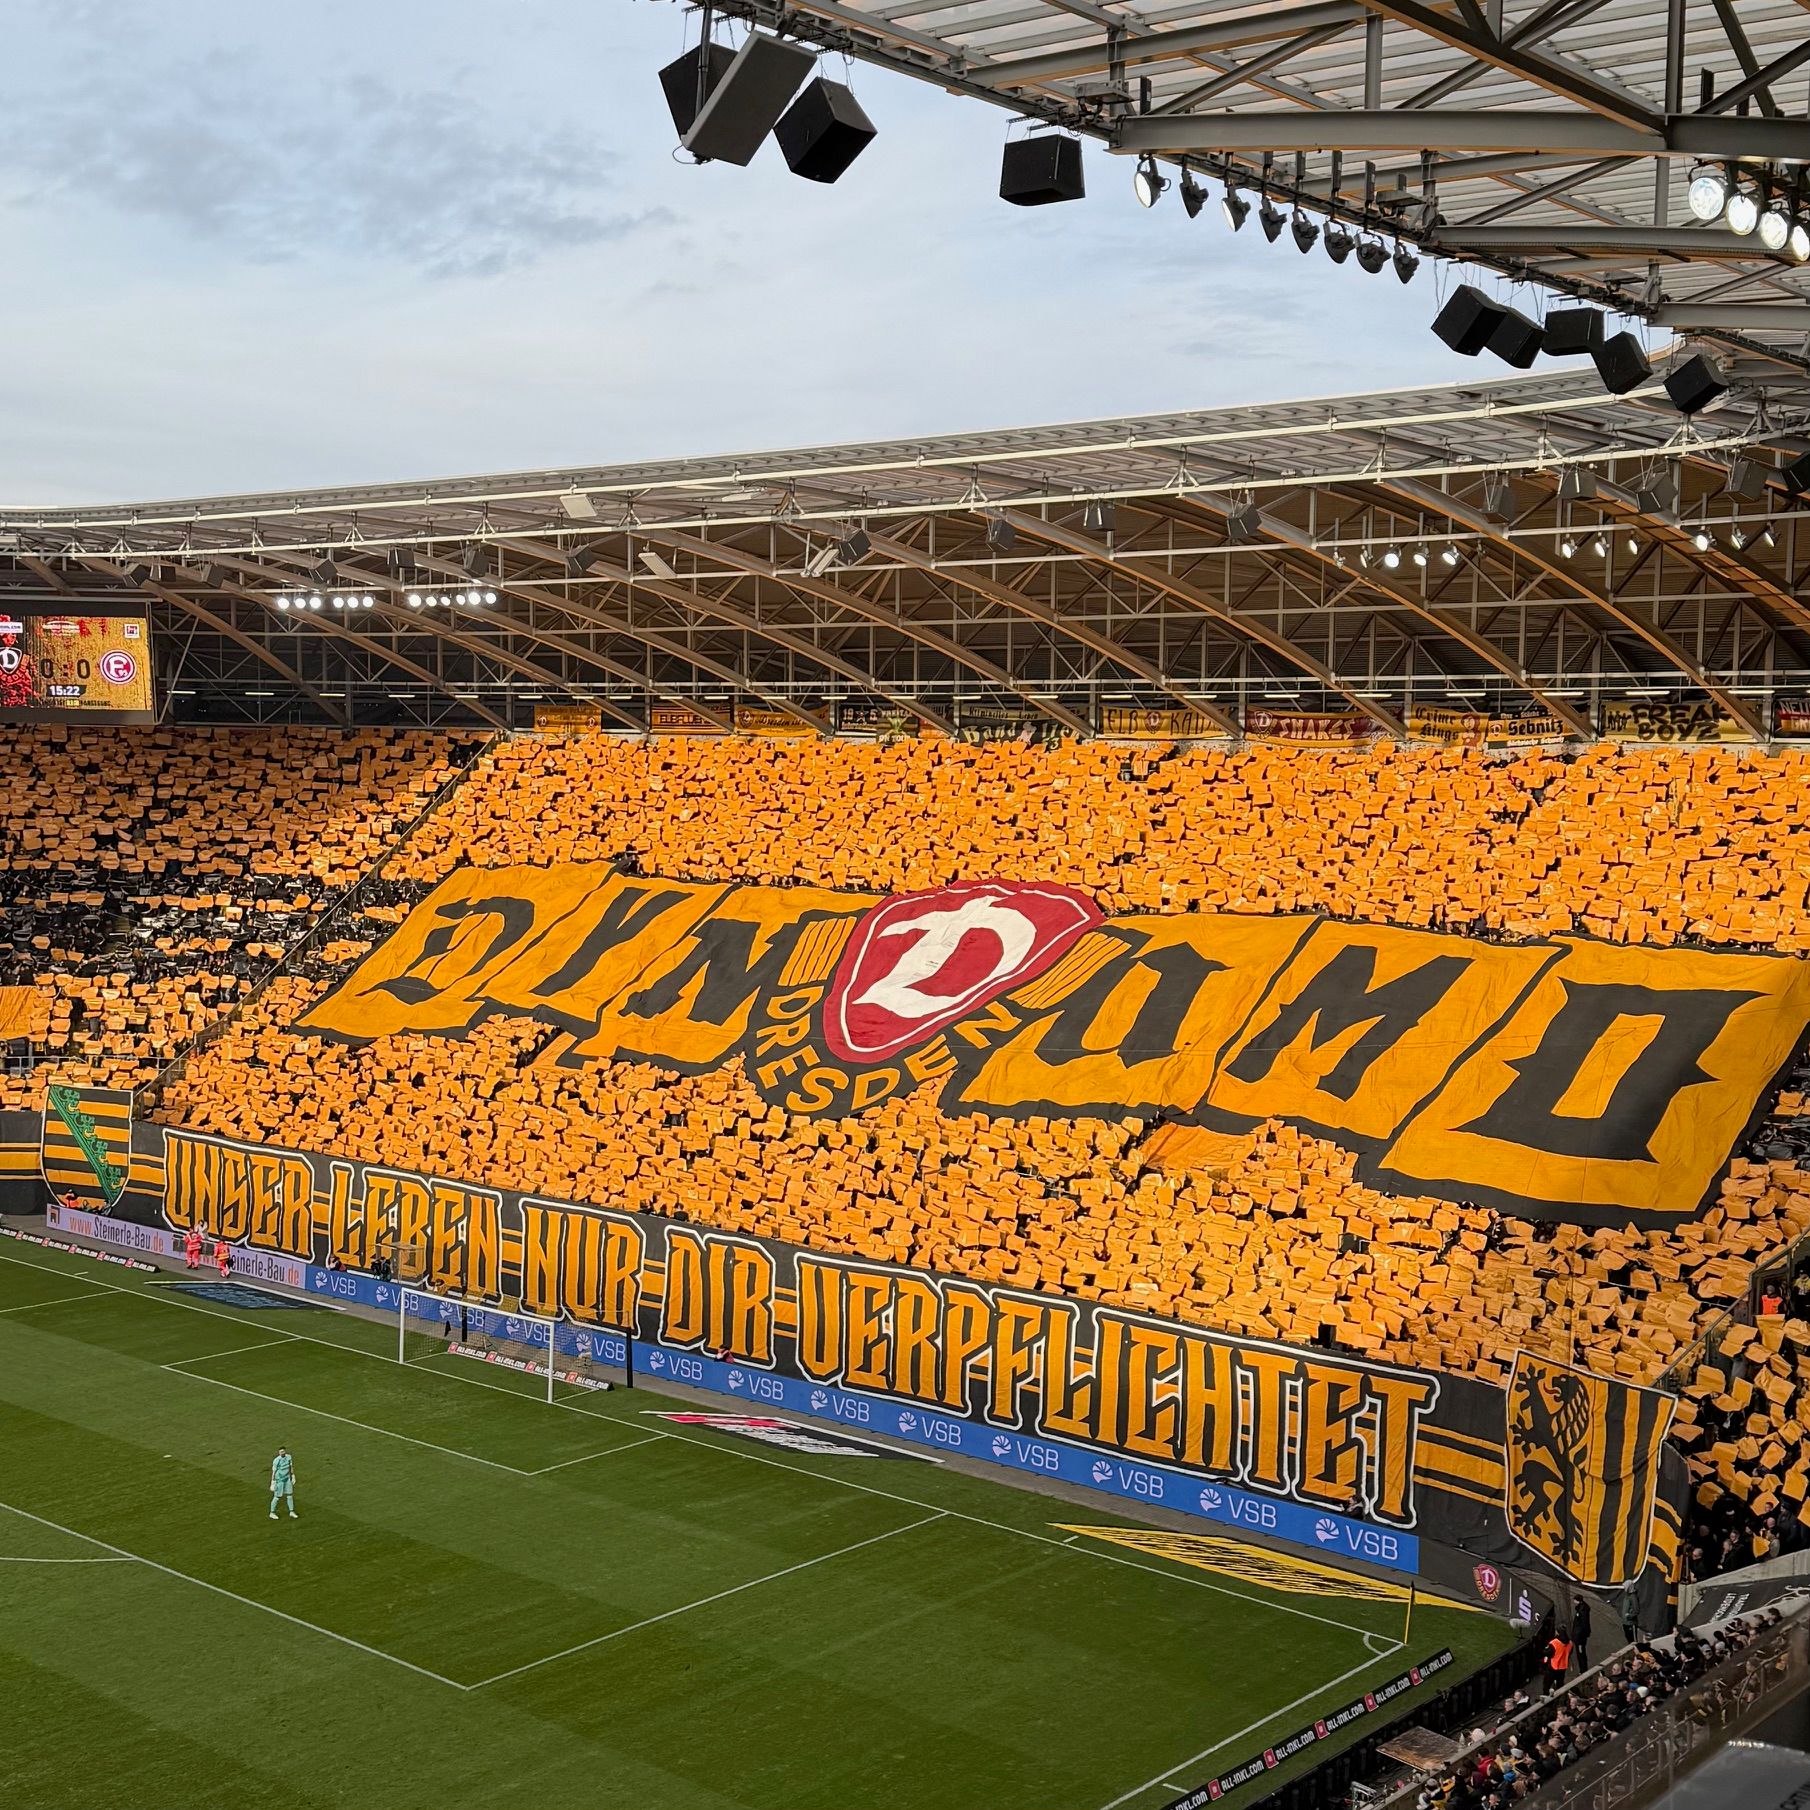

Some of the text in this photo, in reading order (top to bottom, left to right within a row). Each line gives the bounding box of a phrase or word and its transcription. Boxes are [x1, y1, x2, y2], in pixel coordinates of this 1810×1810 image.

[40, 658, 53, 679] 0
[76, 658, 91, 679] 0
[50, 685, 81, 697] 15:22
[1107, 709, 1139, 735] ELB
[1415, 706, 1457, 725] Crime
[1508, 718, 1563, 736] Sebnitz
[1279, 718, 1356, 741] SNAKES
[1420, 723, 1460, 742] Kings
[1637, 721, 1722, 742] BOYZ
[753, 983, 1023, 1114] DRESDEN
[69, 1216, 164, 1253] www.Steinerle-Bau.de
[330, 1275, 357, 1297] VSB
[163, 1132, 1433, 1520] UNSER LEBEN NUR DIR VERPFLICHTET
[522, 1322, 552, 1344] VSB
[593, 1337, 627, 1362] VSB
[668, 1355, 704, 1382] VSB
[747, 1376, 784, 1401] VSB
[831, 1395, 870, 1423] VSB
[921, 1416, 962, 1447] VSB
[1015, 1440, 1060, 1471] VSB
[1118, 1468, 1165, 1499] VSB
[1227, 1498, 1277, 1529] VSB
[1344, 1525, 1399, 1561] VSB
